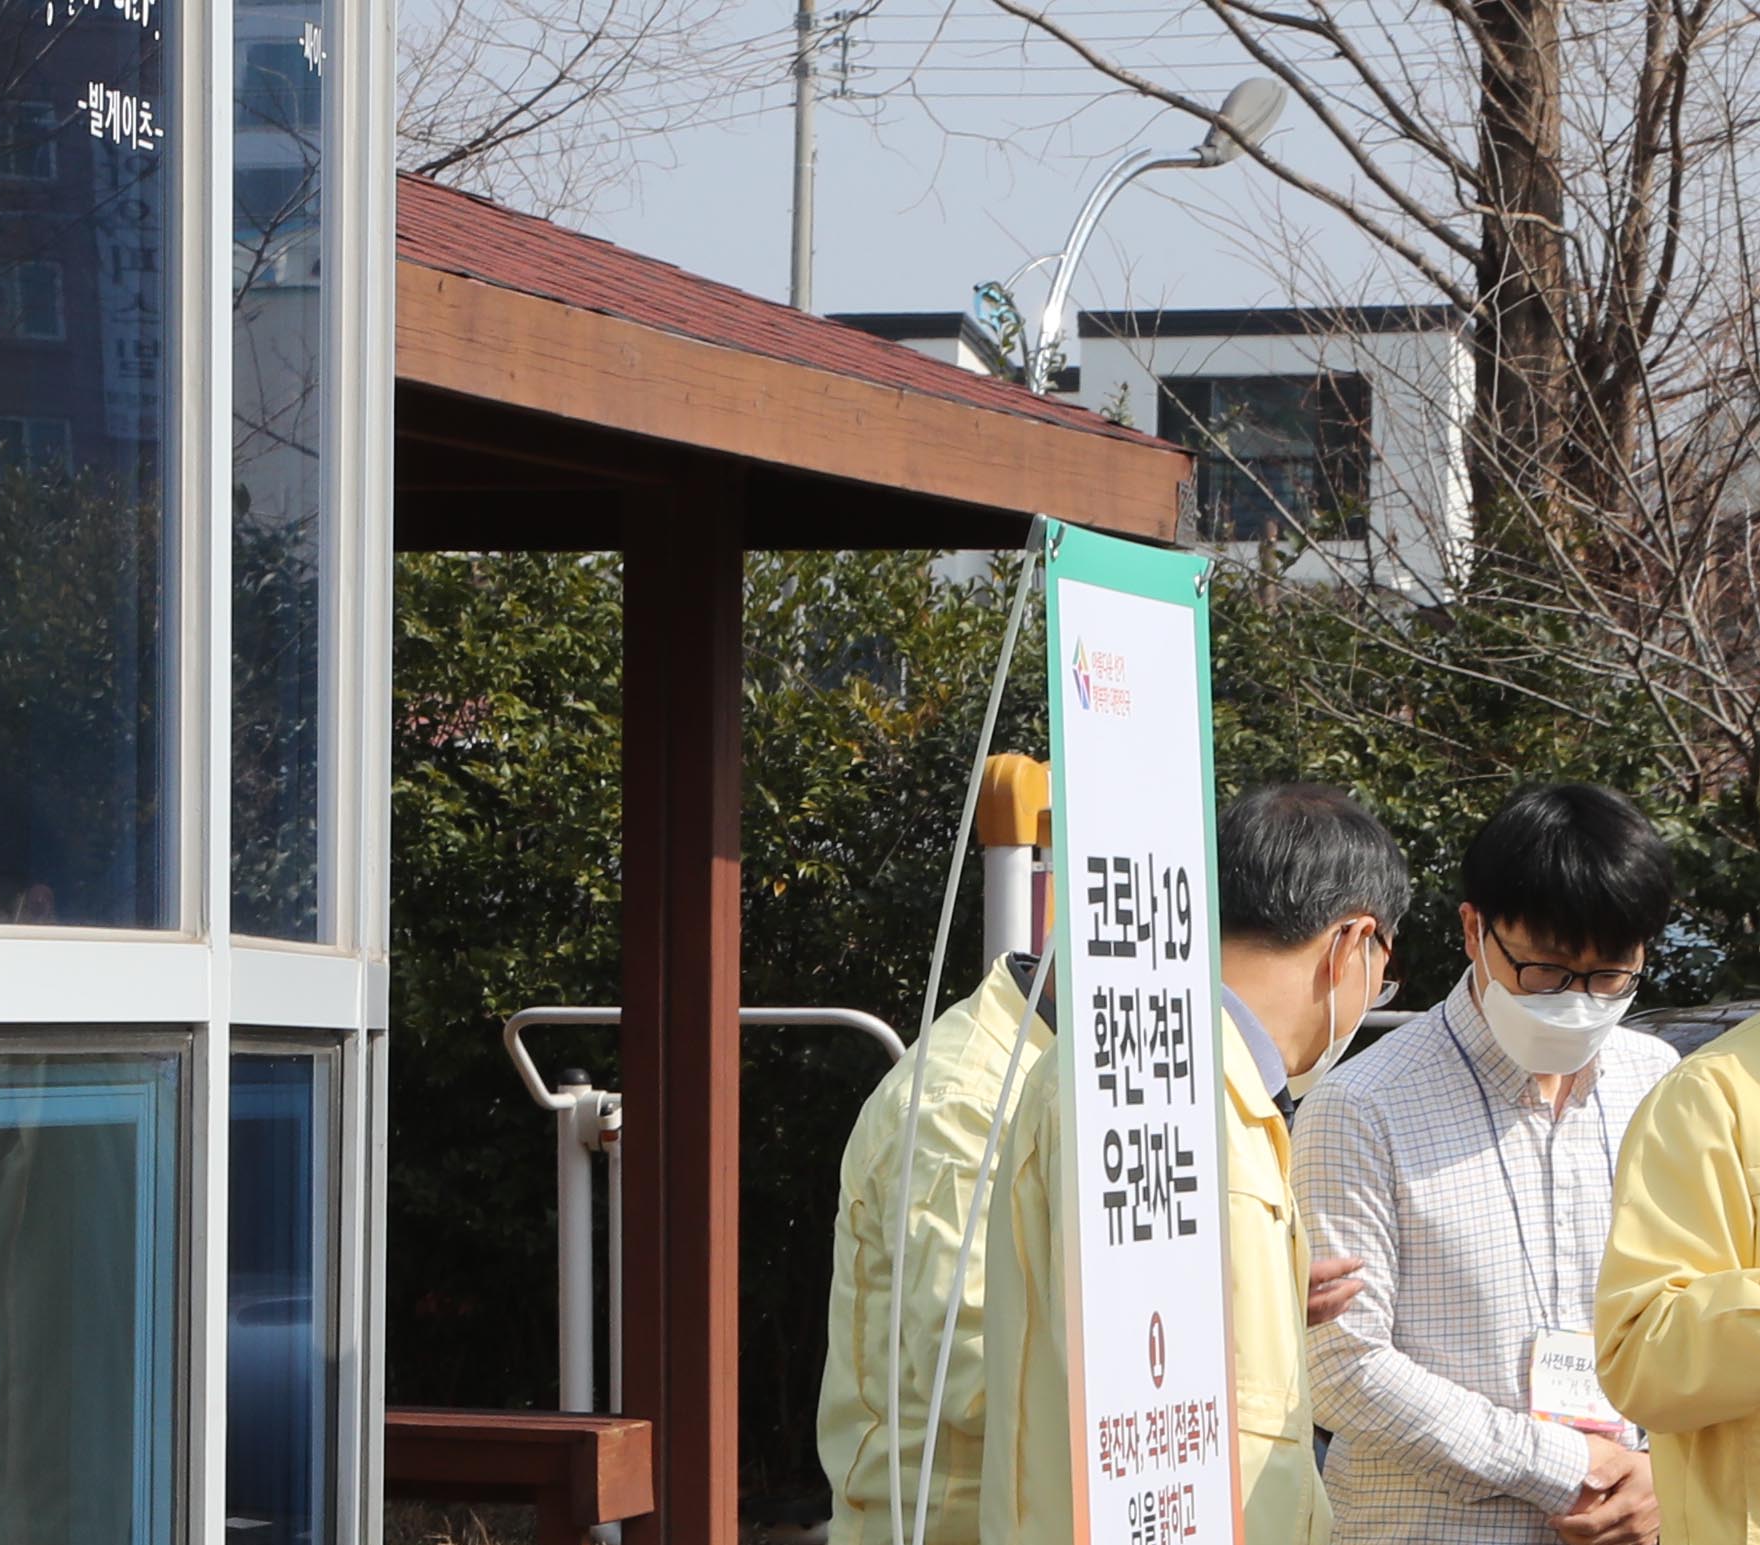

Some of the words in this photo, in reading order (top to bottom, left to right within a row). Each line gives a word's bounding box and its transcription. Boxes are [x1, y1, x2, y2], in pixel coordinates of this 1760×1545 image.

[78, 81, 164, 150] -빌게이츠-
[1087, 852, 1158, 970] 코로나
[1162, 865, 1192, 962] 19
[1102, 1122, 1198, 1246] 유권자는
[1098, 1410, 1144, 1480] 확진자,
[1145, 1395, 1219, 1472] 격리(접촉)자
